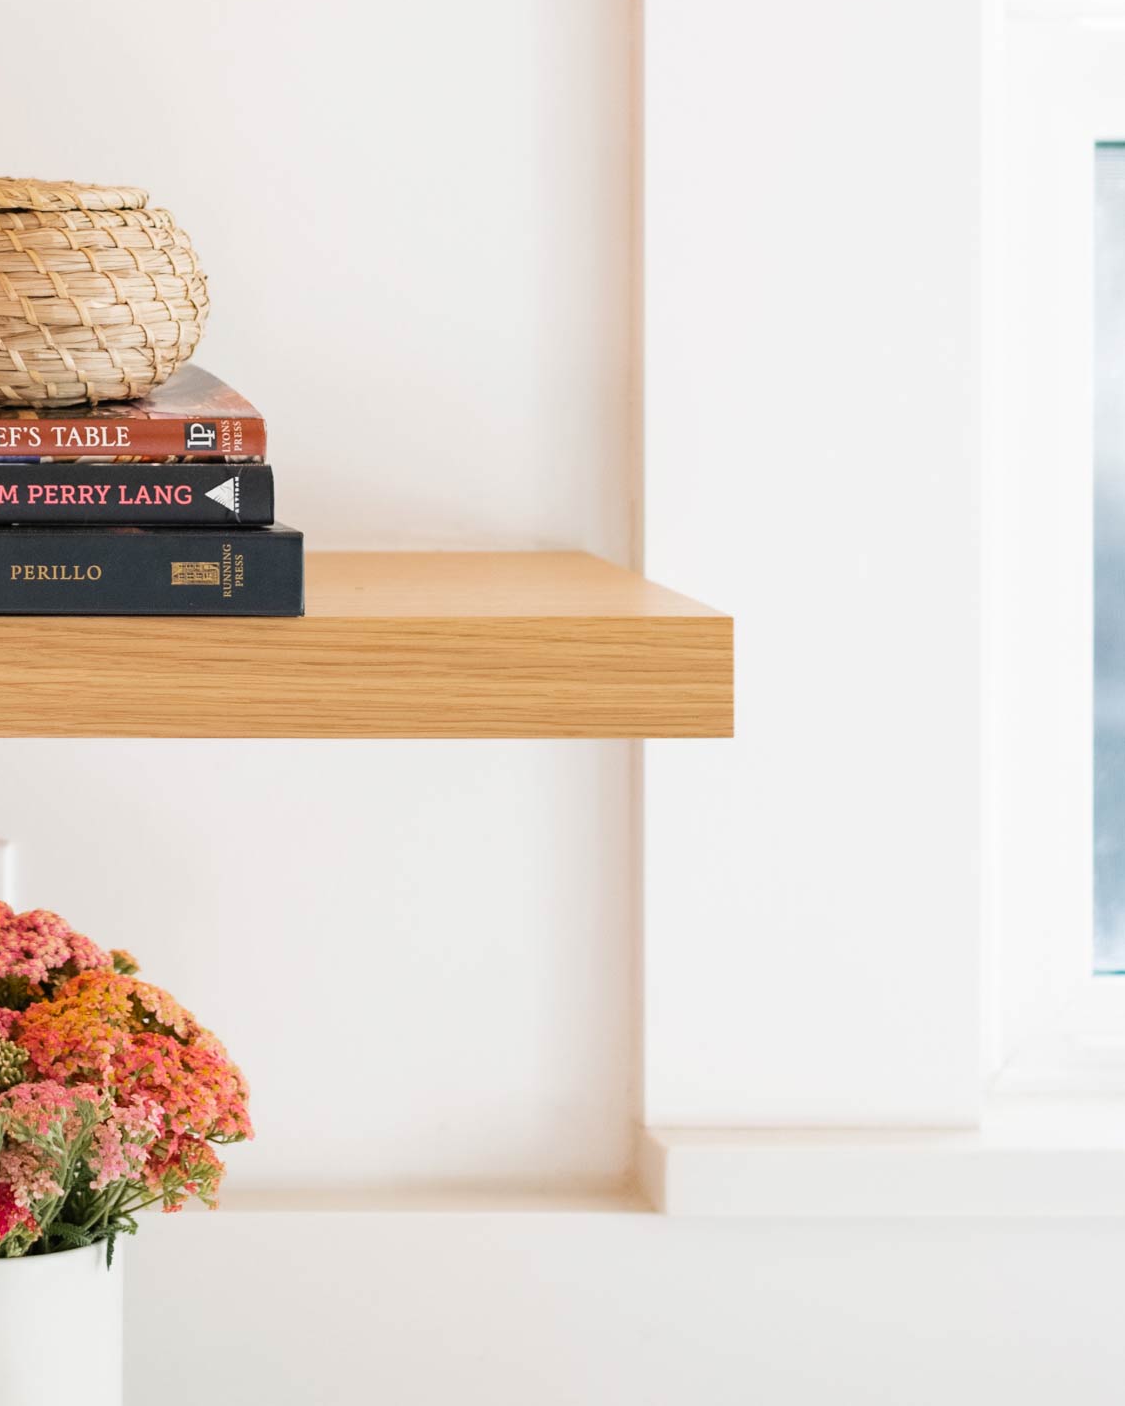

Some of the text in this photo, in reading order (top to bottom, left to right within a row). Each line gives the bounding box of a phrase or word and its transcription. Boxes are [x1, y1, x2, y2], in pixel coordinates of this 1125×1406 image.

[51, 426, 131, 448] TABLE
[221, 420, 230, 453] LYONS
[233, 421, 243, 452] PRESS
[27, 484, 111, 505] PERRY
[118, 484, 192, 505] LANG
[10, 564, 102, 581] PERILLO
[223, 543, 232, 598] RUNNING
[235, 554, 244, 587] PRESS
